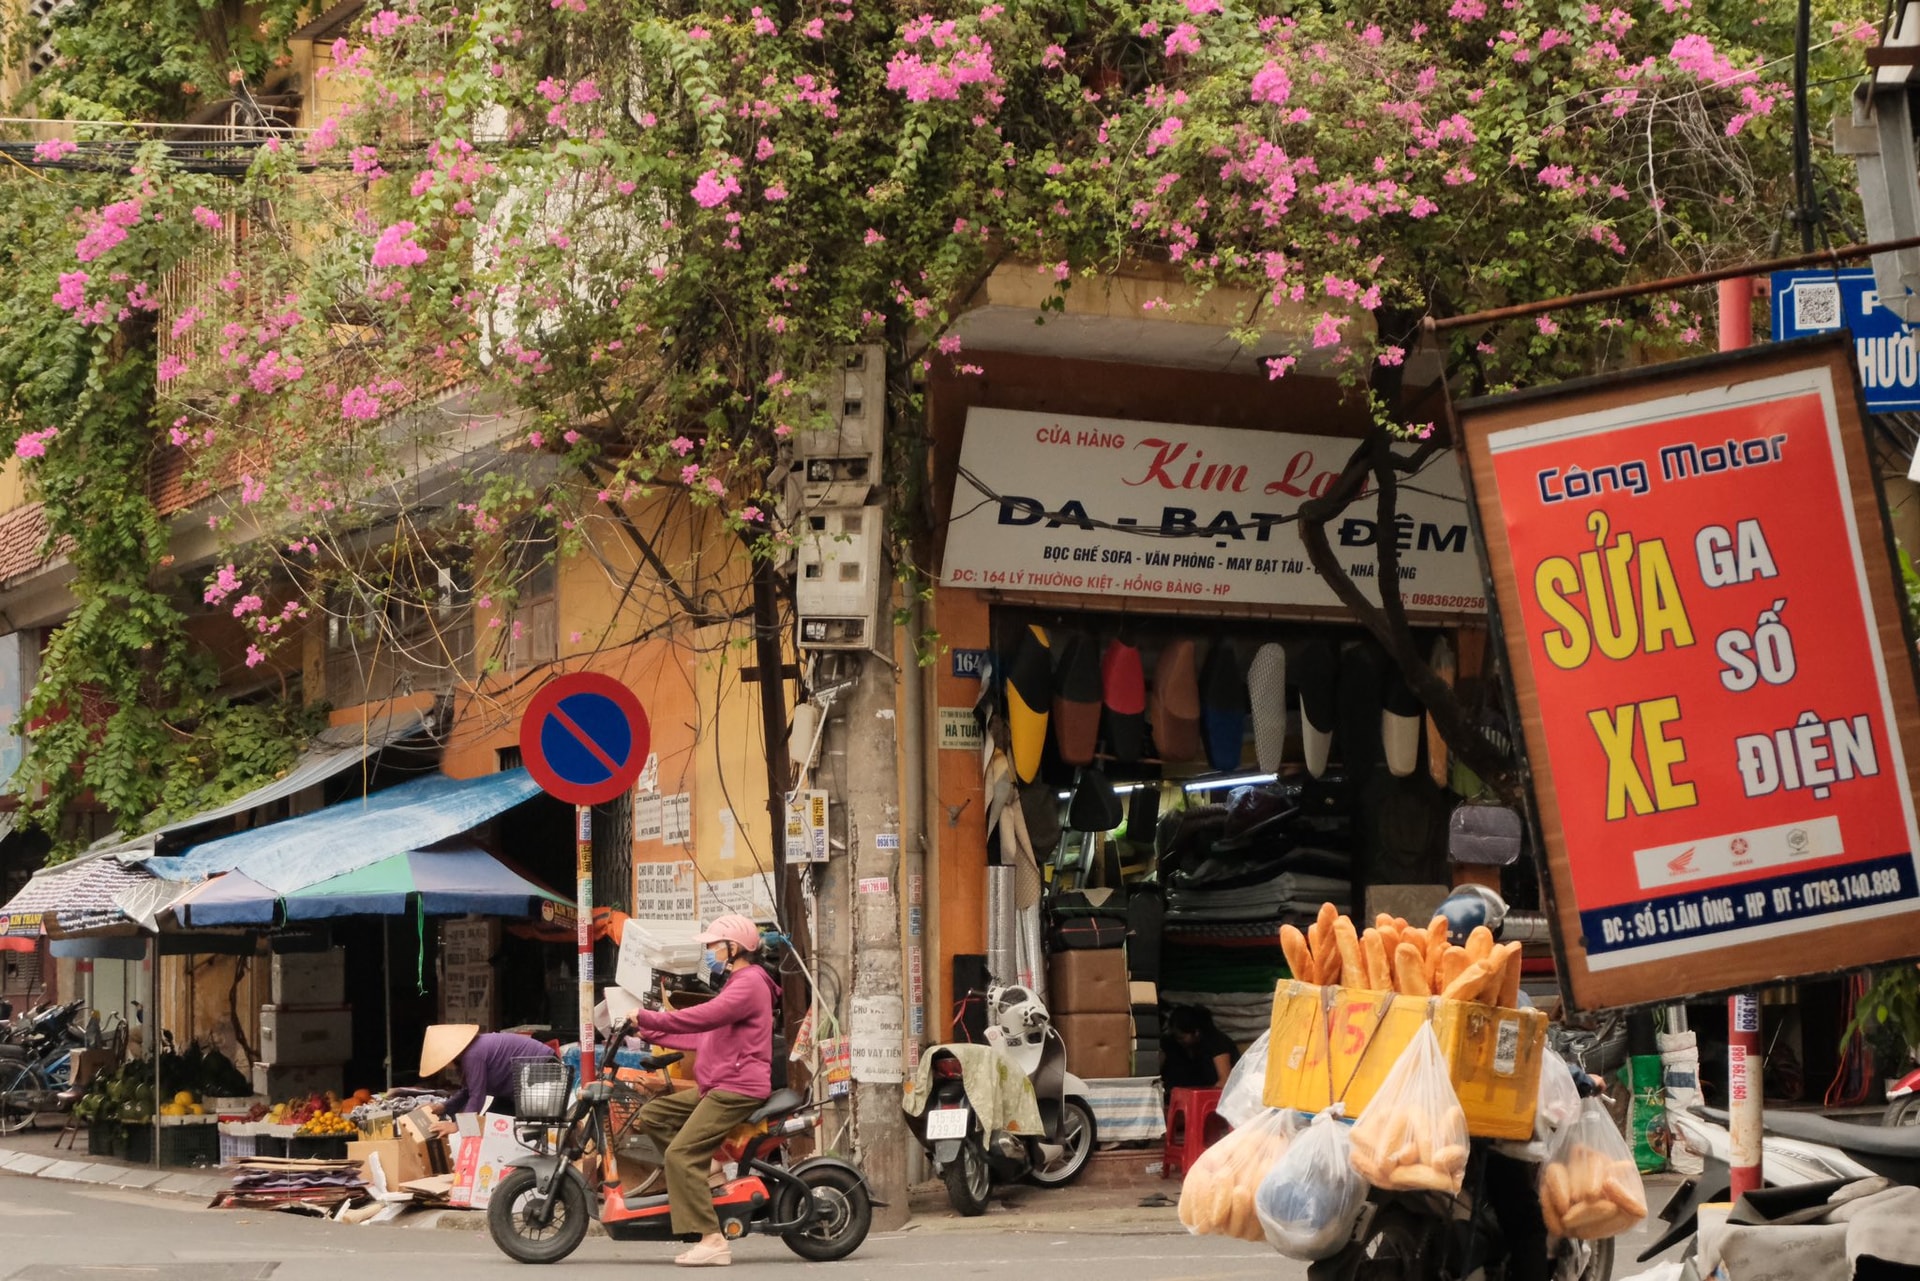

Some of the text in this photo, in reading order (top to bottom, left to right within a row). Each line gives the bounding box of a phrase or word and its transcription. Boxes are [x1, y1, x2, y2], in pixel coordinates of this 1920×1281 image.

[1036, 427, 1125, 449] CỬA HÀNG
[1121, 438, 1369, 499] Kim La
[1538, 433, 1787, 505] Công Motor
[997, 495, 1095, 531] DA
[1160, 506, 1283, 548] BẠT
[1695, 518, 1779, 588] GA
[951, 569, 977, 583] ĐC:
[982, 570, 1006, 584] 164
[1009, 567, 1025, 584] LÝ
[1028, 570, 1083, 587] THƯỜNG
[1087, 577, 1114, 592] KIỆT
[1123, 573, 1163, 592] HỒNG
[1166, 577, 1203, 594] BÀNG
[1213, 584, 1231, 595] HP
[1043, 546, 1069, 563] BỌC
[1073, 545, 1101, 562] GHẾ
[1101, 550, 1133, 564] SOFA
[1145, 551, 1170, 567] VĂN
[1172, 552, 1215, 569] PHÒNG
[1226, 557, 1252, 571] MAY
[1255, 560, 1277, 575] BẠT
[1281, 557, 1304, 574] TÀU
[1350, 561, 1375, 577] NHÀ
[1535, 509, 1697, 670] SỬA
[1412, 593, 1486, 609] 0983620258
[956, 653, 982, 673] 164
[1715, 598, 1796, 692] SỐ
[1586, 695, 1698, 821] XE
[1737, 710, 1880, 800] ĐIỆN
[1602, 919, 1625, 943] ĐC
[1636, 903, 1656, 938] SỐ
[1658, 909, 1668, 933] 5
[1669, 902, 1702, 932] LÃN
[1705, 893, 1735, 926] ÔNG
[1745, 893, 1766, 919] HP
[1772, 887, 1793, 914] ĐT
[1804, 868, 1901, 909] 0793.140.888
